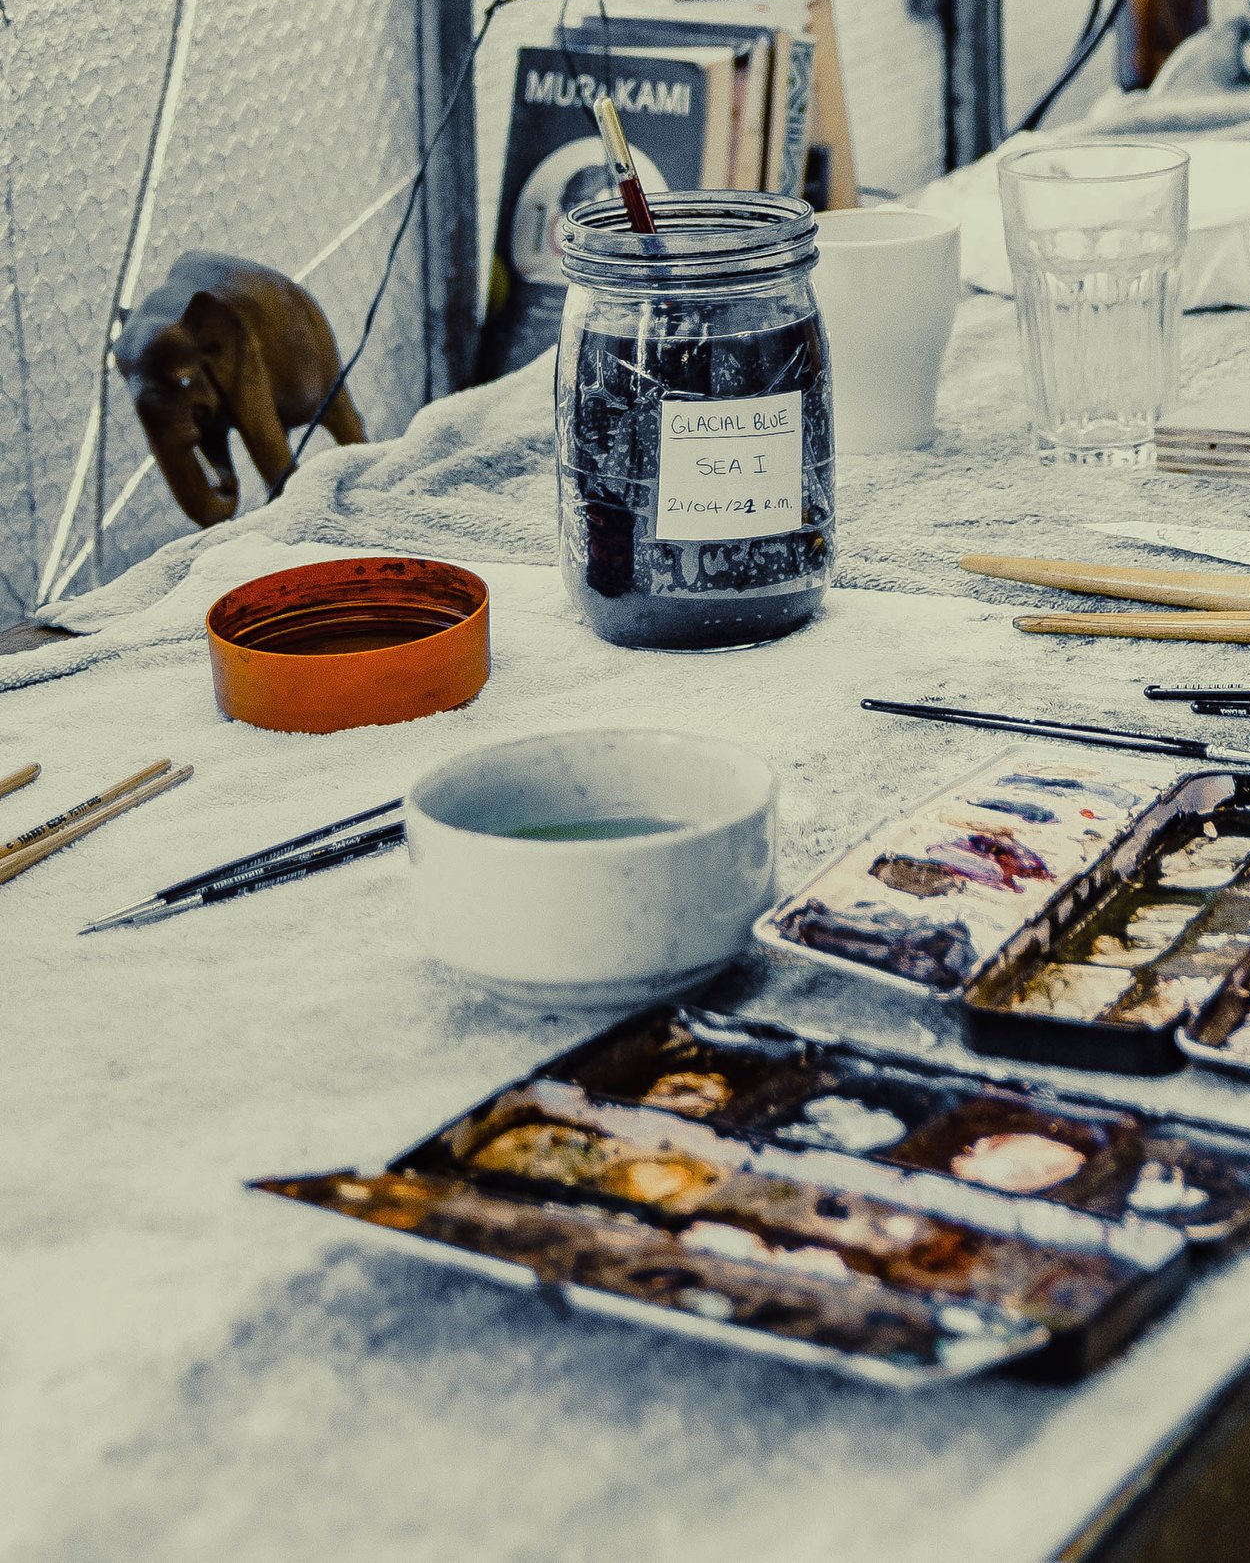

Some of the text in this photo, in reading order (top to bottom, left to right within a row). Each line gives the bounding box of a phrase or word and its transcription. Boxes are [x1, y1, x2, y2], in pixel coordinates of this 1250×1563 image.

[671, 408, 790, 435] GLACIAL BLUE
[695, 454, 768, 476] SEA I
